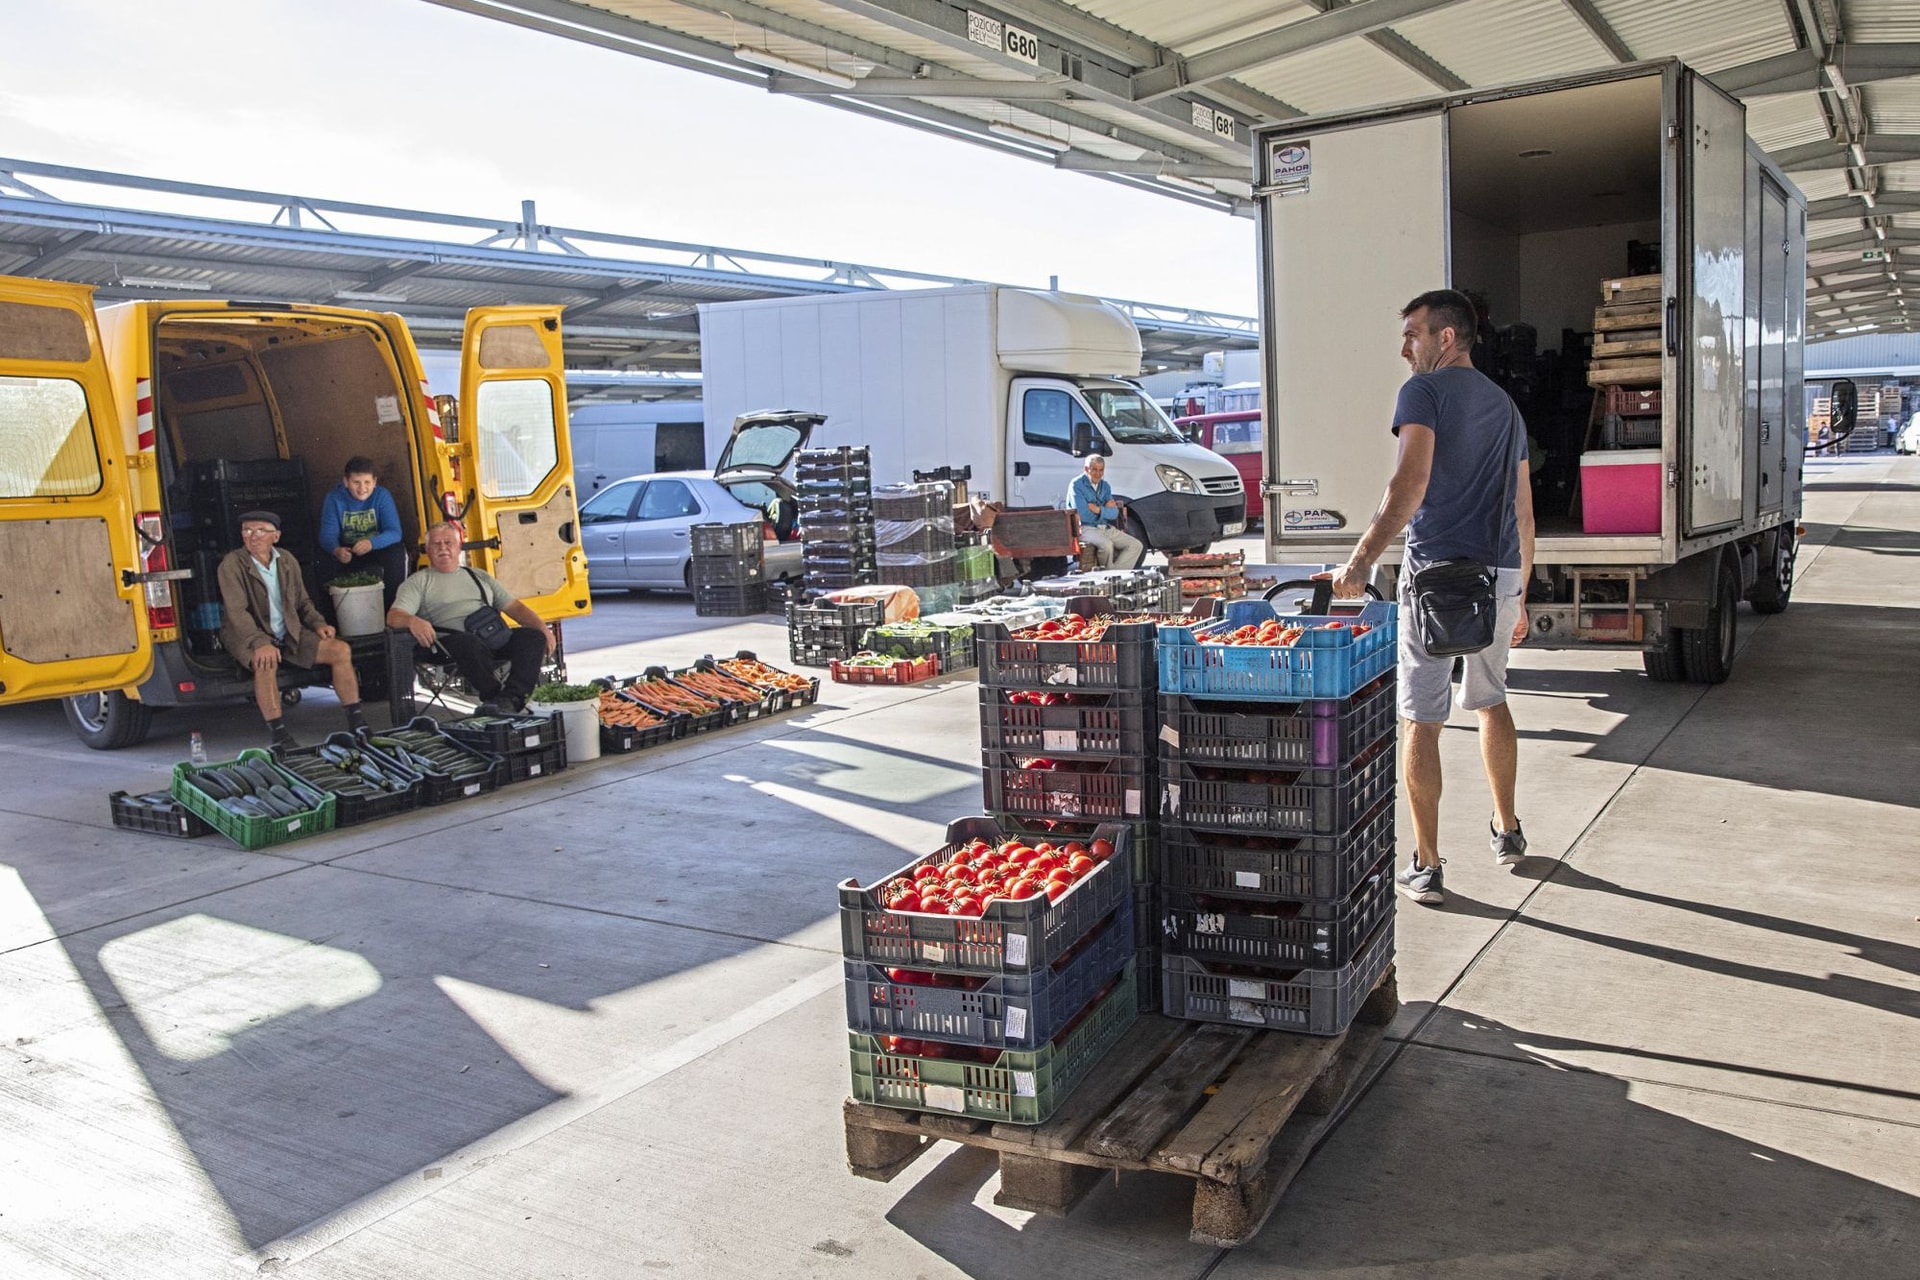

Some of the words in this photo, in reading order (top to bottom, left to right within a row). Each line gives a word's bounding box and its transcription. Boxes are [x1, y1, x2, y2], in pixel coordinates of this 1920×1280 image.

[970, 27, 987, 43] HELY
[1007, 31, 1037, 60] G80
[1216, 116, 1234, 137] G81
[1275, 164, 1309, 174] PAHOR
